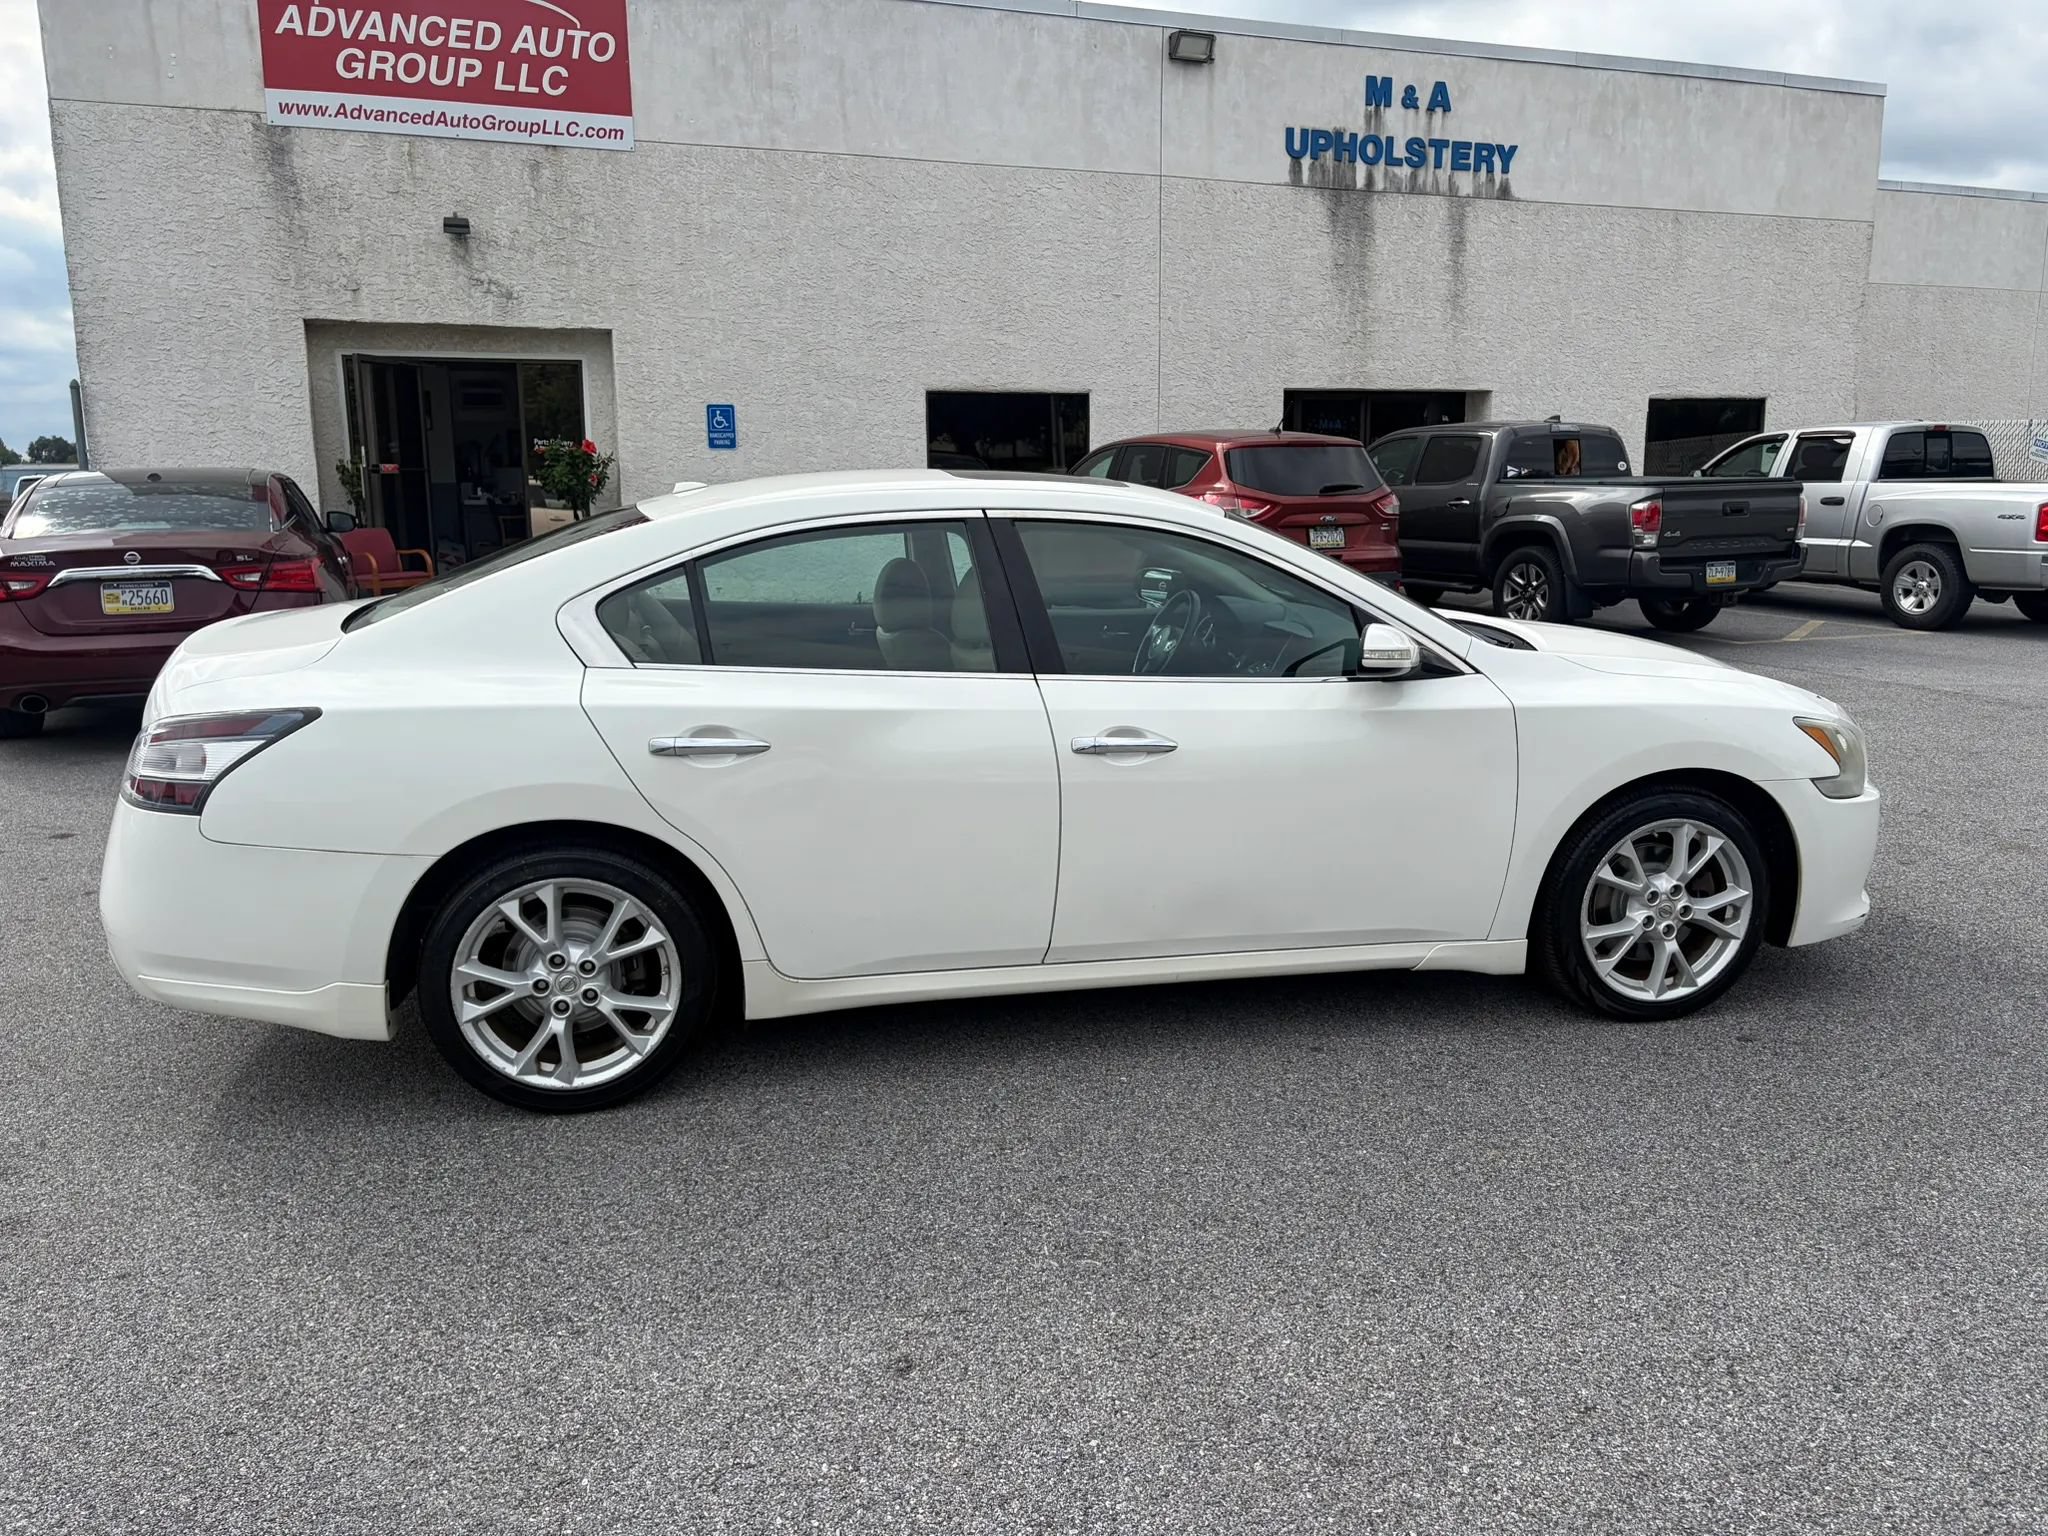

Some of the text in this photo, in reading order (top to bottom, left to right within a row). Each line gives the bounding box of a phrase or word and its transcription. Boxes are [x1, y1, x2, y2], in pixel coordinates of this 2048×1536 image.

[275, 4, 616, 62] ADVANCED AUTO
[336, 47, 568, 96] GROUP LLC
[1365, 75, 1452, 112] M & A
[278, 101, 625, 141] www.AdvancedAutoGroupLLC.com
[1285, 127, 1518, 174] UPHOLSTERY
